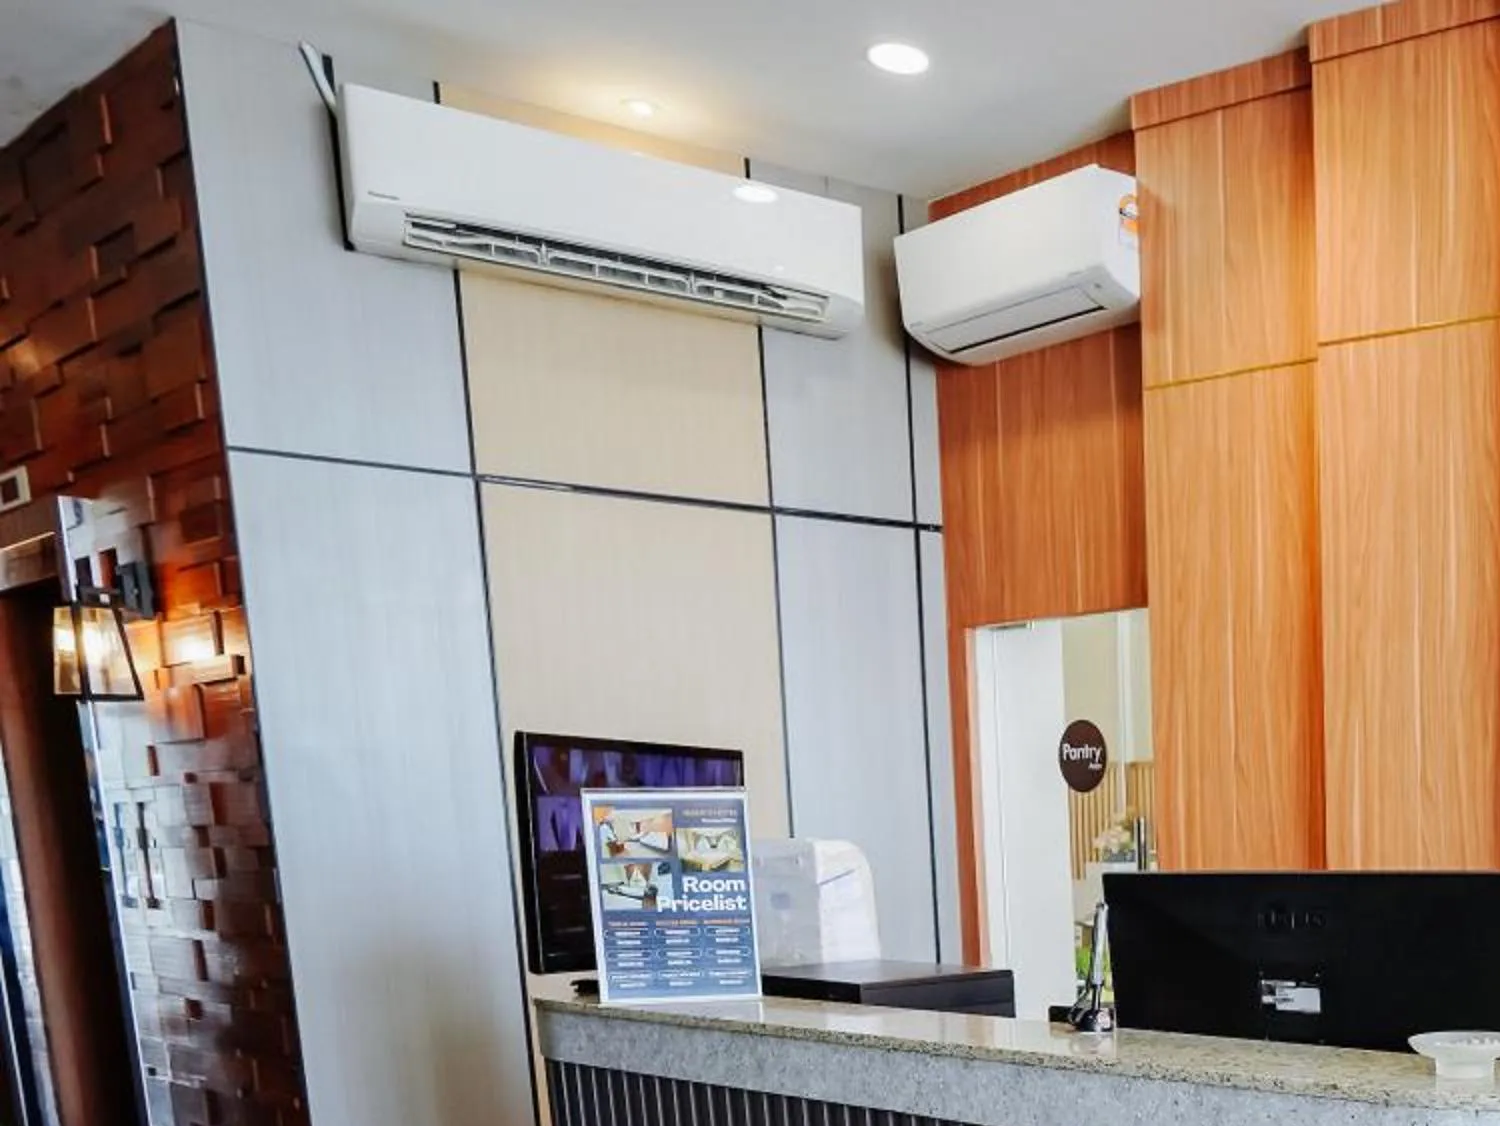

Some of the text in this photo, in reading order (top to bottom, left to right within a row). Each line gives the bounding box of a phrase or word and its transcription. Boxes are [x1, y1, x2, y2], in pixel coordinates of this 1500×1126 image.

[1062, 743, 1102, 763] Pantry
[682, 876, 746, 893] Room
[657, 894, 747, 913] Pricelist
